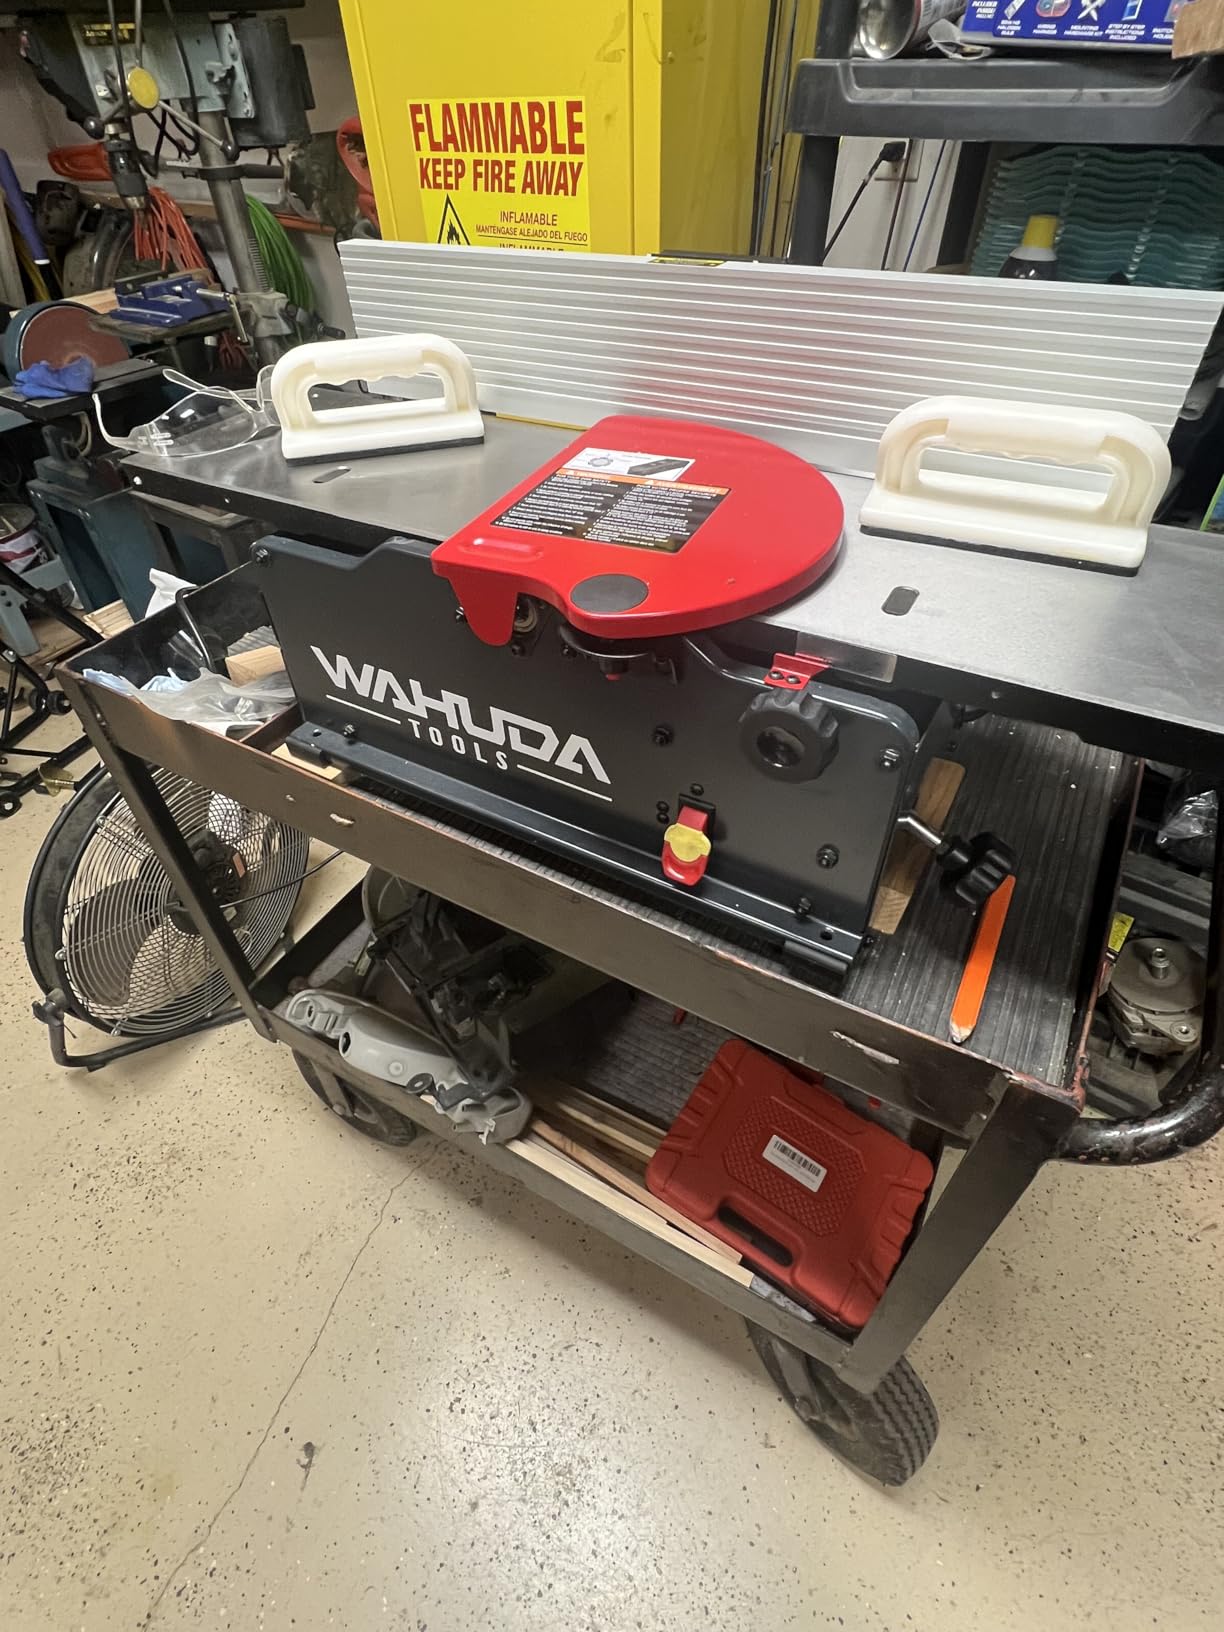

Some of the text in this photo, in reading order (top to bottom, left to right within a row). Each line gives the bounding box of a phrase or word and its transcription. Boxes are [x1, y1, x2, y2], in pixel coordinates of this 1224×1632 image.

[408, 100, 585, 155] FLAMMABLE
[419, 158, 584, 197] KEEP FIRE AWAY
[500, 210, 558, 226] INFLAMABLE
[519, 228, 548, 239] ALEJADO
[549, 230, 563, 240] DEL
[564, 231, 588, 242] FUEGO
[310, 645, 612, 785] WAHUDA
[408, 718, 509, 770] TOOLS
